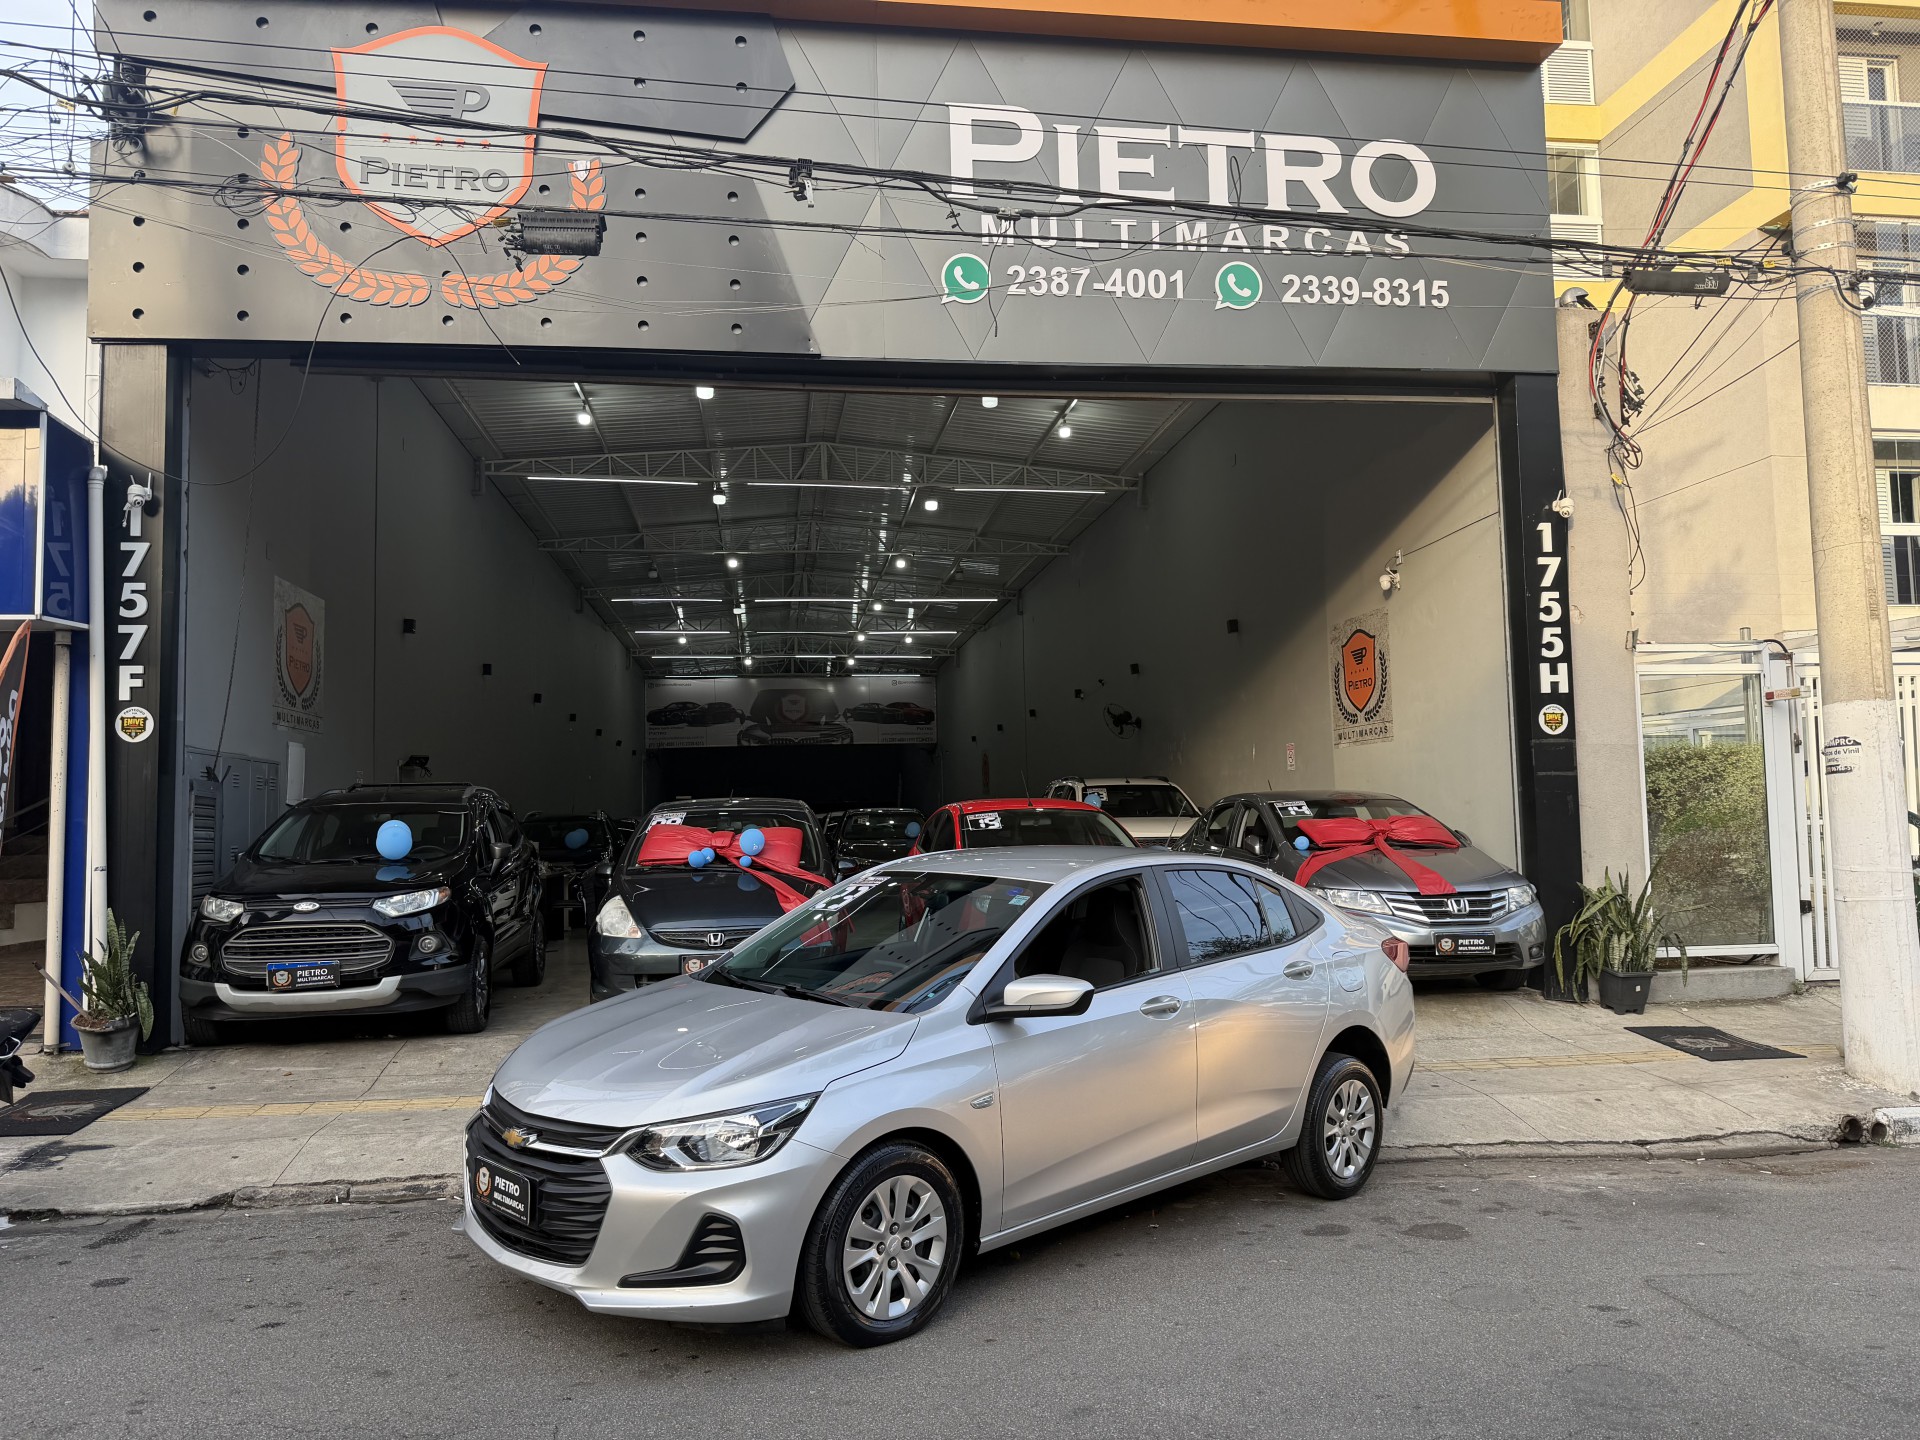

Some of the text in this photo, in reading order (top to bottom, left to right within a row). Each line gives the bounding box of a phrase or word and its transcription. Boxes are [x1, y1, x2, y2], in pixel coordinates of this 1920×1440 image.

[945, 102, 1437, 218] PIETRO
[359, 155, 510, 193] PIETRO
[980, 214, 1412, 260] MULTIMARCAS
[1006, 265, 1185, 299] 2387-4001
[1281, 273, 1450, 309] 2339-8315
[117, 507, 151, 701] 1757F
[1535, 522, 1570, 694] 1755H
[288, 655, 311, 673] PIETRO
[1348, 677, 1373, 691] PIETRO
[276, 711, 320, 730] MULTIMARCAS
[1338, 725, 1389, 740] MULTIMARCAS
[296, 968, 328, 977] PIETRO
[297, 975, 334, 983] MULTIMARCAS
[494, 1175, 520, 1197] PIETRO
[493, 1191, 525, 1212] MULTIMARCAS
